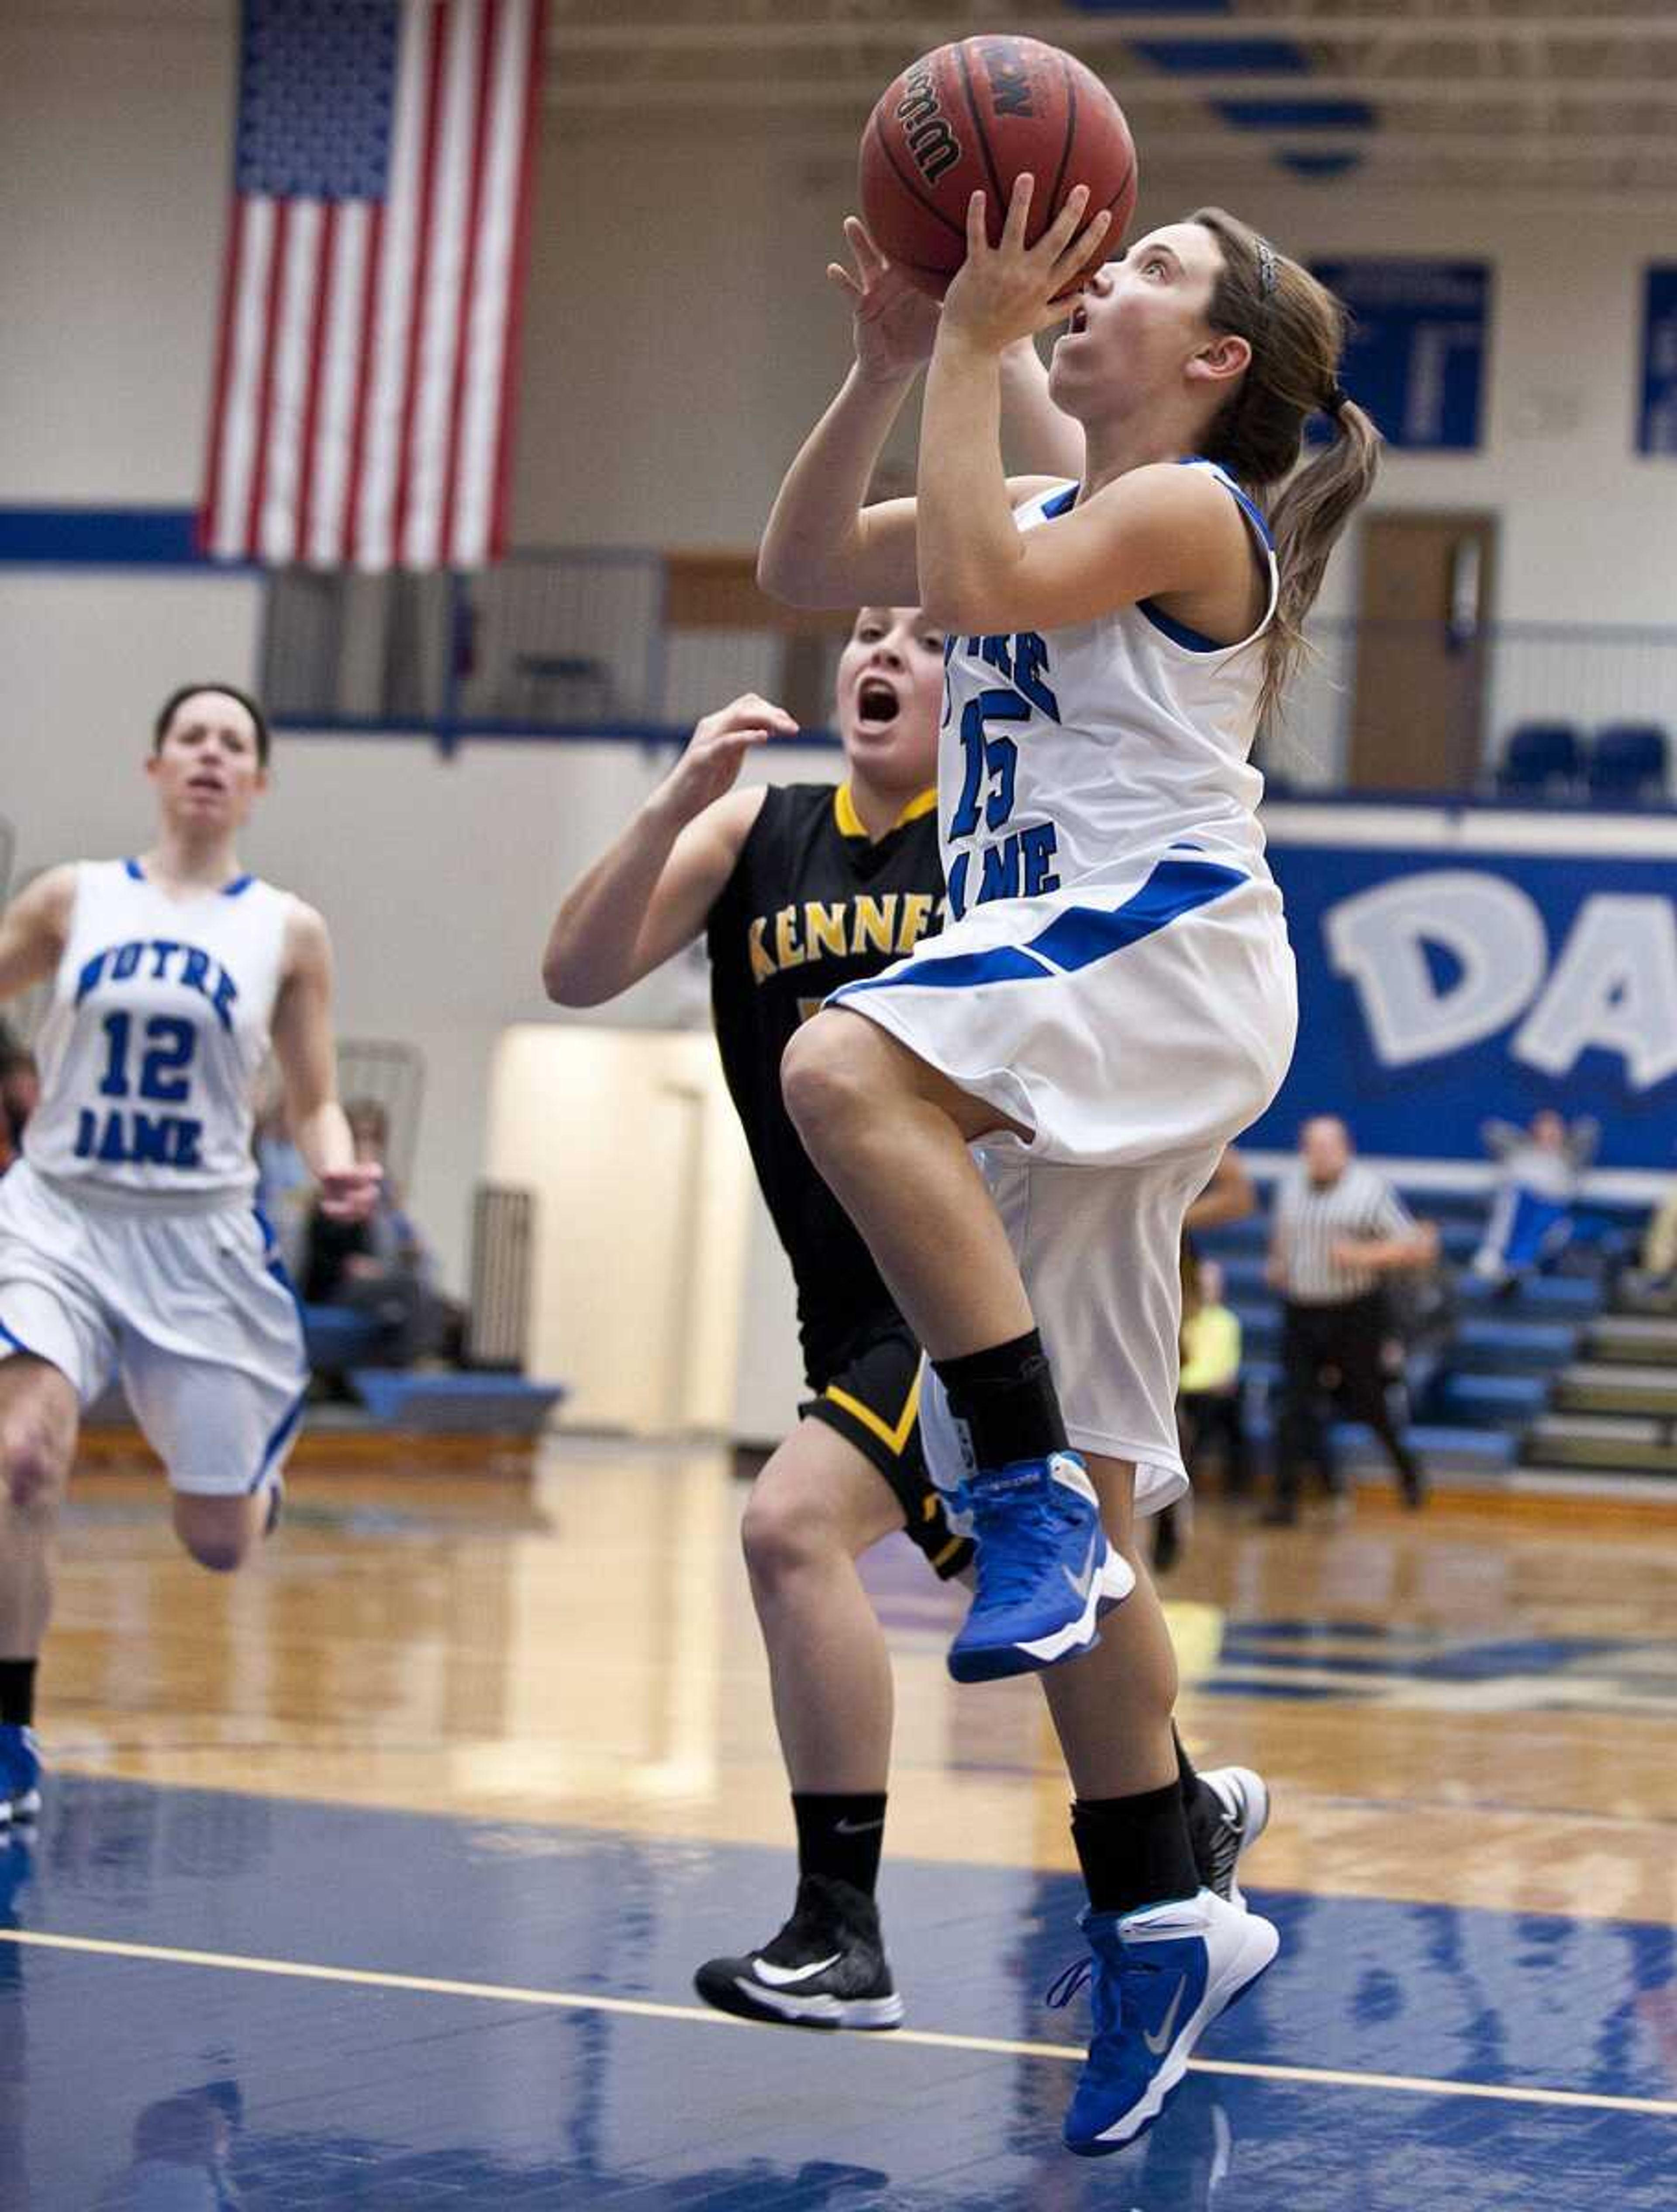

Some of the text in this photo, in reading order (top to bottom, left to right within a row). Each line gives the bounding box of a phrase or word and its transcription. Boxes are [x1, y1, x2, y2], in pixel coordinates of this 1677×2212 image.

[947, 688, 1032, 844] 15
[749, 894, 948, 985] KENNE
[100, 1011, 196, 1101] 12
